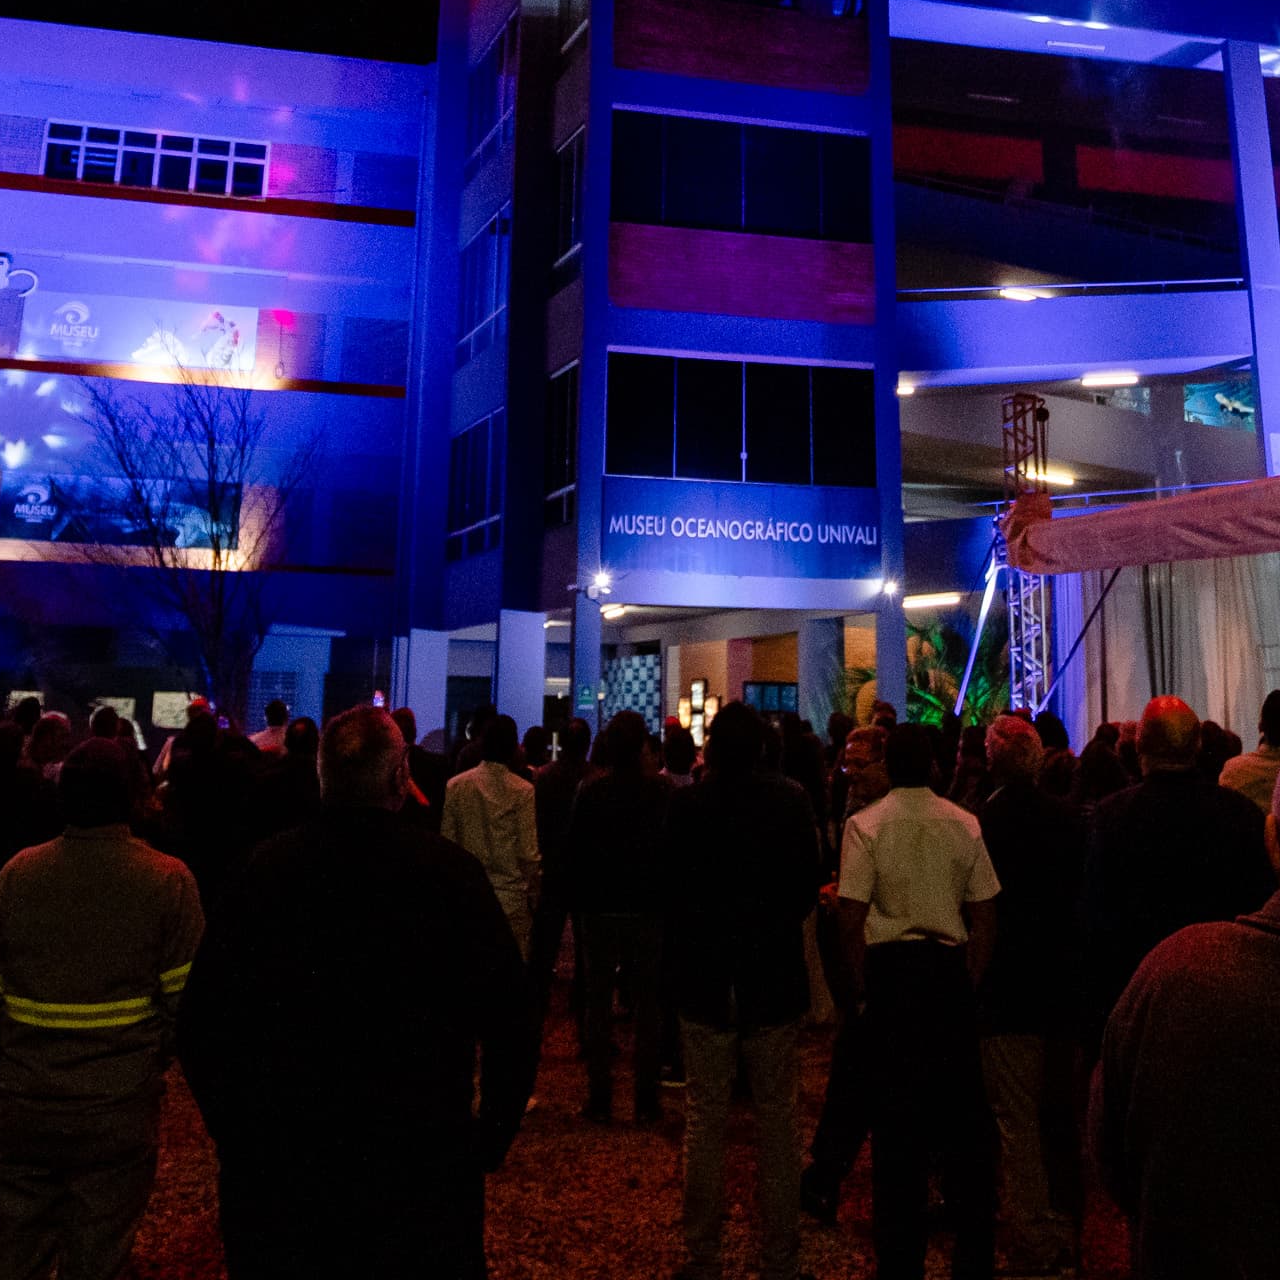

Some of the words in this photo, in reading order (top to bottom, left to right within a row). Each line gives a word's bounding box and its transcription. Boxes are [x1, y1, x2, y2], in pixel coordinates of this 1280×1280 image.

[50, 323, 98, 338] MUSEU
[609, 515, 666, 536] MUSEU
[671, 516, 813, 543] OCEANOGRÁFICO
[817, 523, 877, 545] UNIVALI
